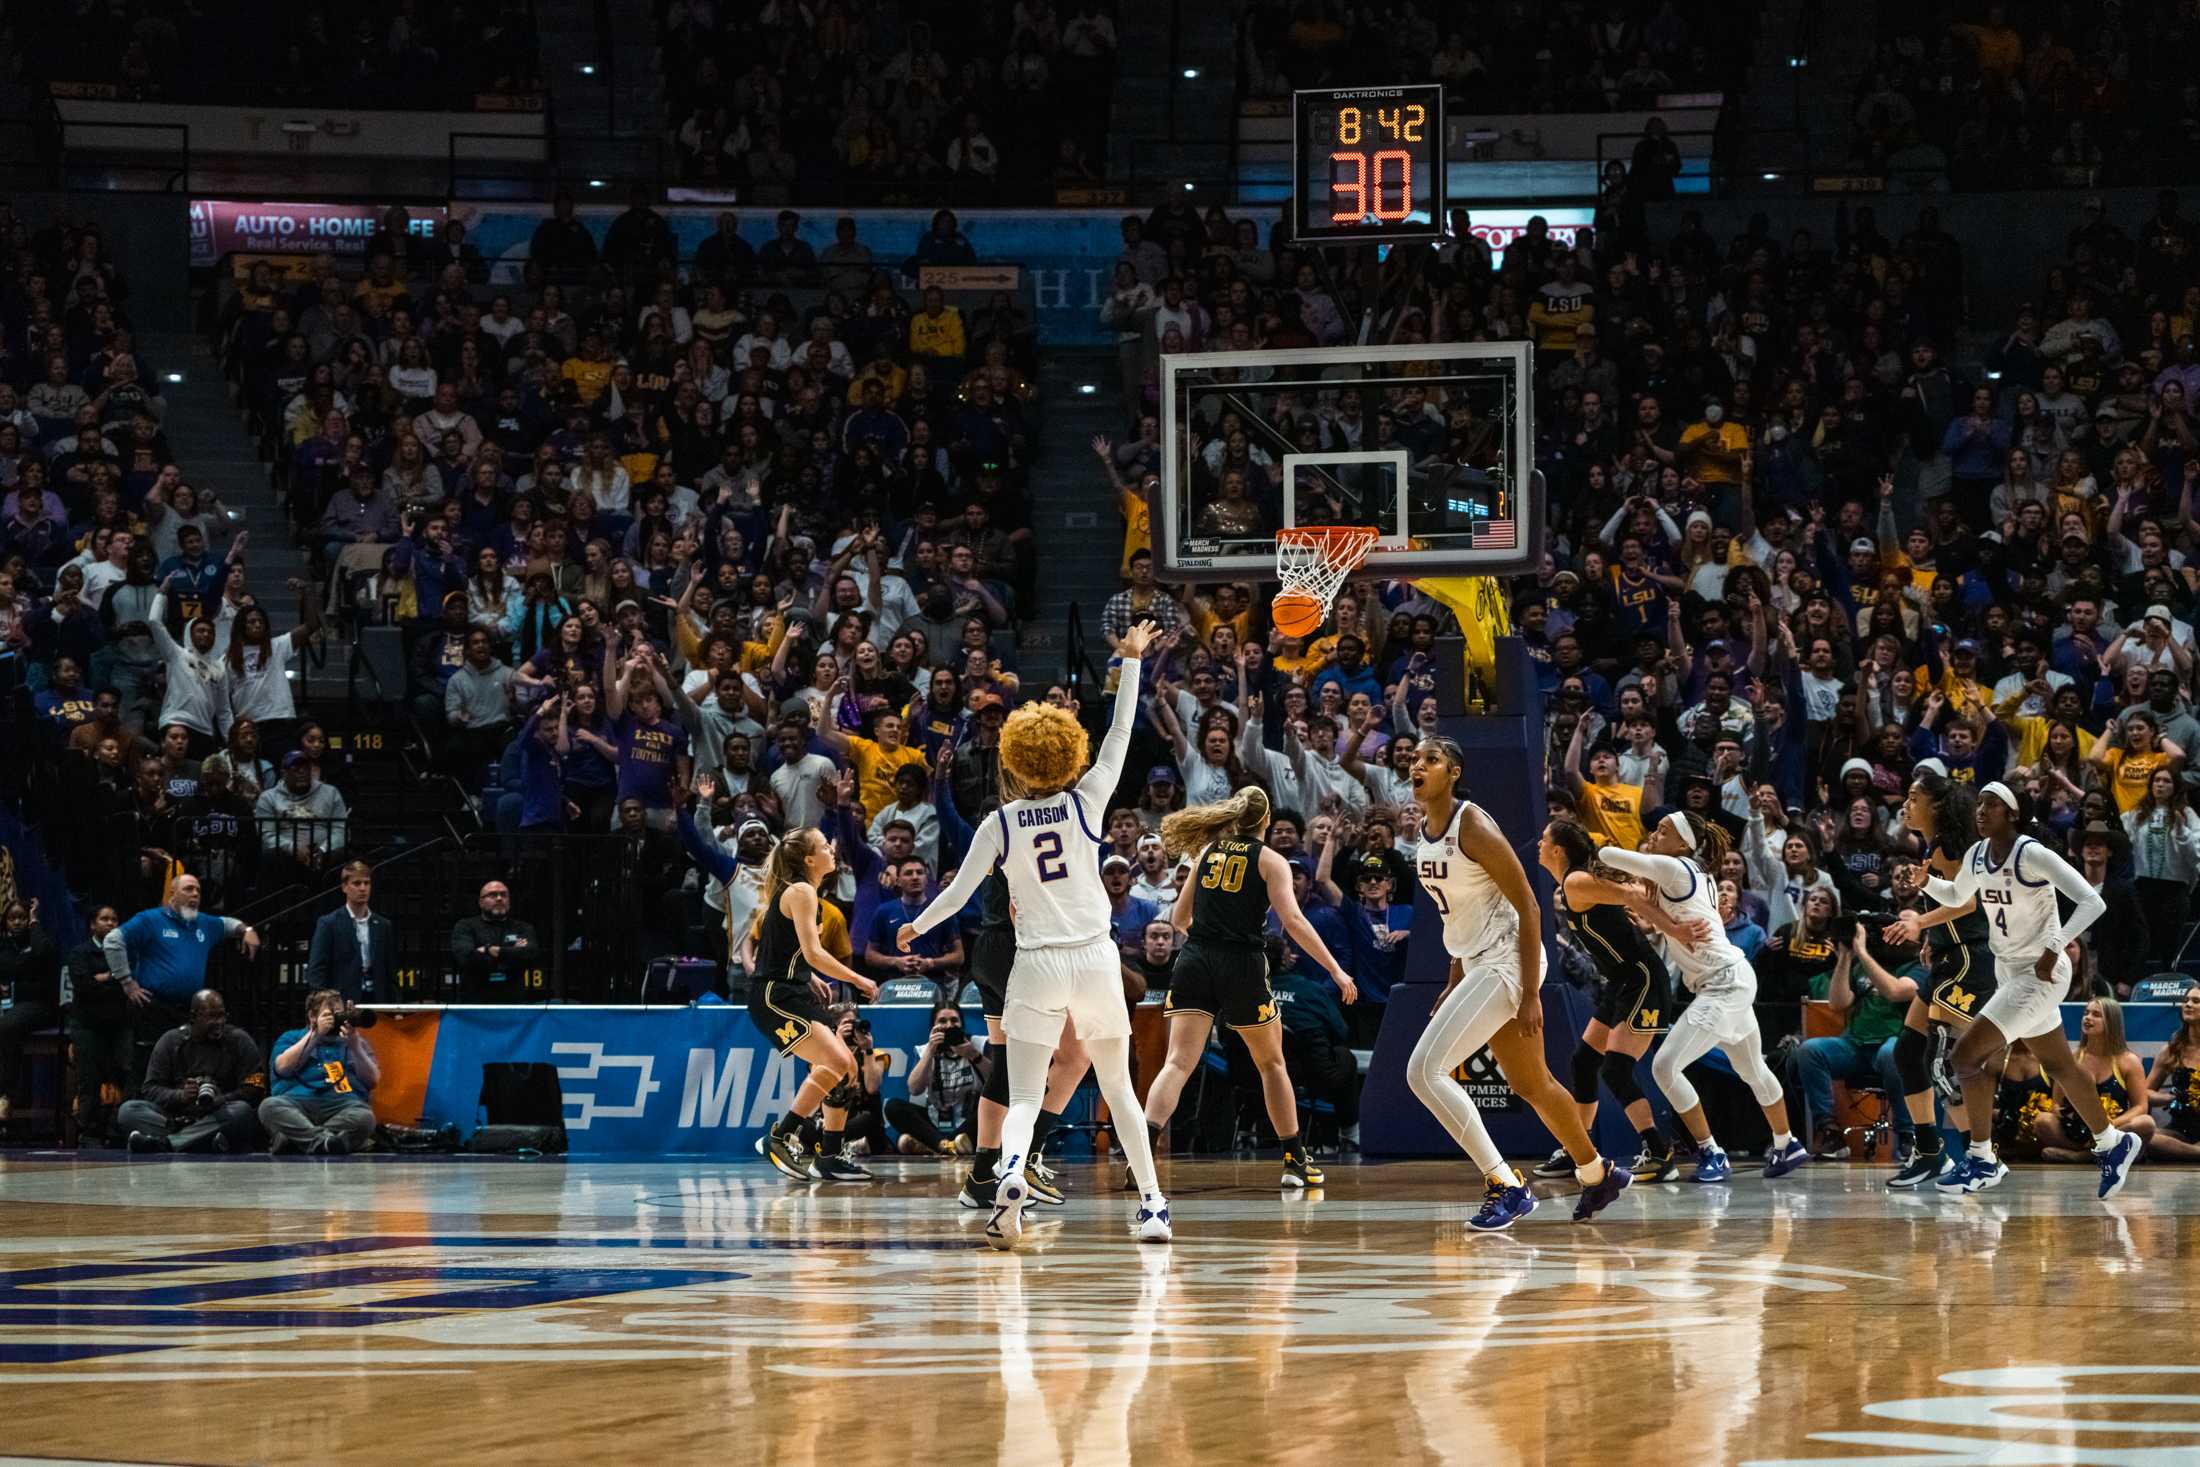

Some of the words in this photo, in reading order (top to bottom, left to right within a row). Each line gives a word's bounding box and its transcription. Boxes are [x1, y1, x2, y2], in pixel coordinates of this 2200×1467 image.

[1333, 90, 1403, 99] DAKTRONICS
[1331, 150, 1412, 222] 30
[235, 215, 296, 233] AUTO
[309, 217, 376, 236] HOME
[247, 237, 276, 249] Real
[1547, 297, 1582, 312] LSU
[1191, 545, 1220, 553] MADNESS
[1177, 559, 1213, 567] SPALDING
[1622, 587, 1657, 607] LSU
[353, 733, 383, 750] 118
[1017, 804, 1069, 828] CARSON
[1218, 840, 1250, 853] STUCK
[1033, 831, 1068, 883] 2
[1201, 852, 1248, 893] 30
[1419, 860, 1449, 879] SU
[1994, 907, 2009, 937] 4
[894, 983, 922, 992] MARCH
[896, 990, 933, 998] MADNESS
[2149, 981, 2180, 990] MARCH
[1945, 984, 1977, 1013] M
[1641, 1009, 1660, 1028] M
[775, 1020, 799, 1045] M
[1464, 1085, 1515, 1096] IPMENT
[1473, 1097, 1508, 1108] VICES
